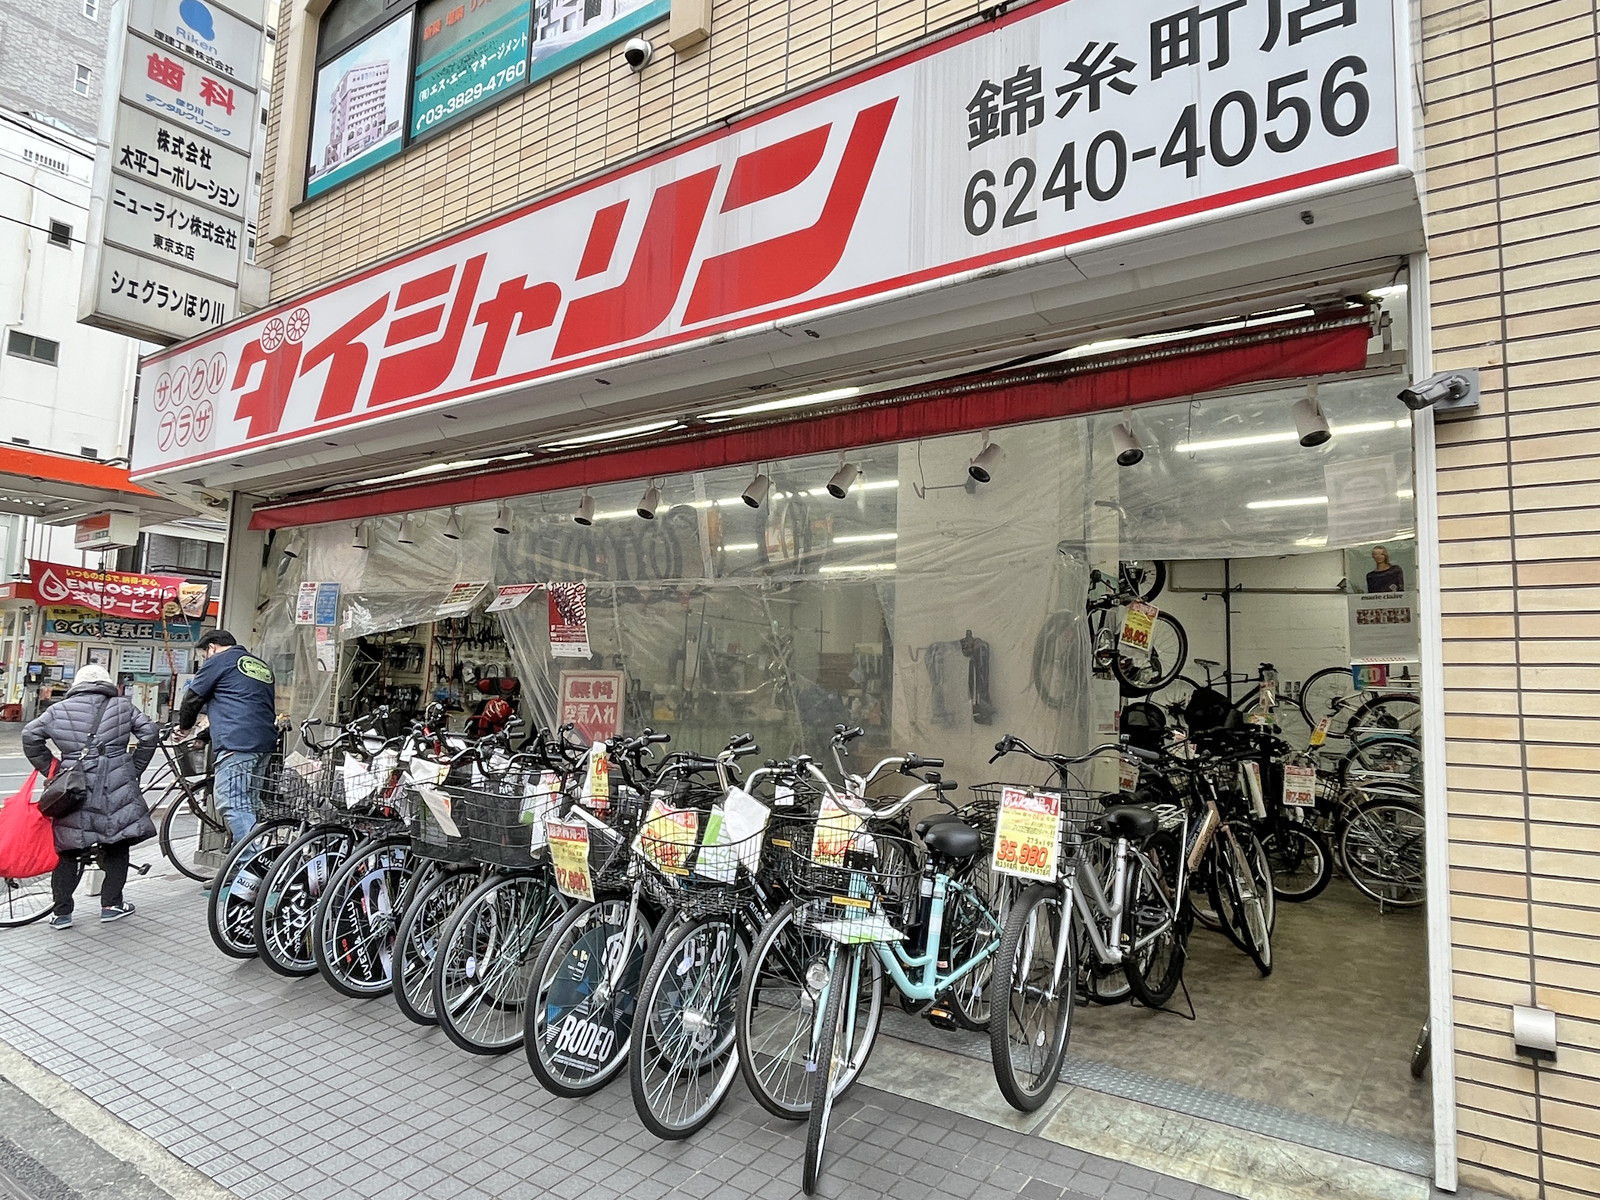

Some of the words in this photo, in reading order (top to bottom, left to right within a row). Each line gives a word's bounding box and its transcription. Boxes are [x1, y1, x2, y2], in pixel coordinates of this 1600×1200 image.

[153, 28, 235, 77] 理建工業株式会社
[176, 26, 218, 56] Riken
[147, 52, 236, 116] 歯科
[425, 59, 527, 125] 03-3829-4760
[965, 0, 1359, 151] 錦糸町店
[145, 93, 232, 137] デンタルクリニック
[157, 128, 212, 171] 株式会社
[963, 54, 1370, 237] 6240-4056
[120, 145, 240, 209] 太平コーポレーション
[113, 188, 238, 251] ニューライン株式会社
[152, 233, 196, 262] 東京支店
[231, 96, 900, 440] ダイシャリン
[110, 270, 226, 325] シェグランほり川
[155, 354, 226, 409] サイクル
[159, 402, 213, 448] プラザ
[569, 680, 614, 700] 無料
[564, 704, 616, 725] 空気入れ
[996, 839, 1049, 868] 35,980
[345, 901, 360, 934] LULU
[554, 1015, 616, 1063] RODEO
